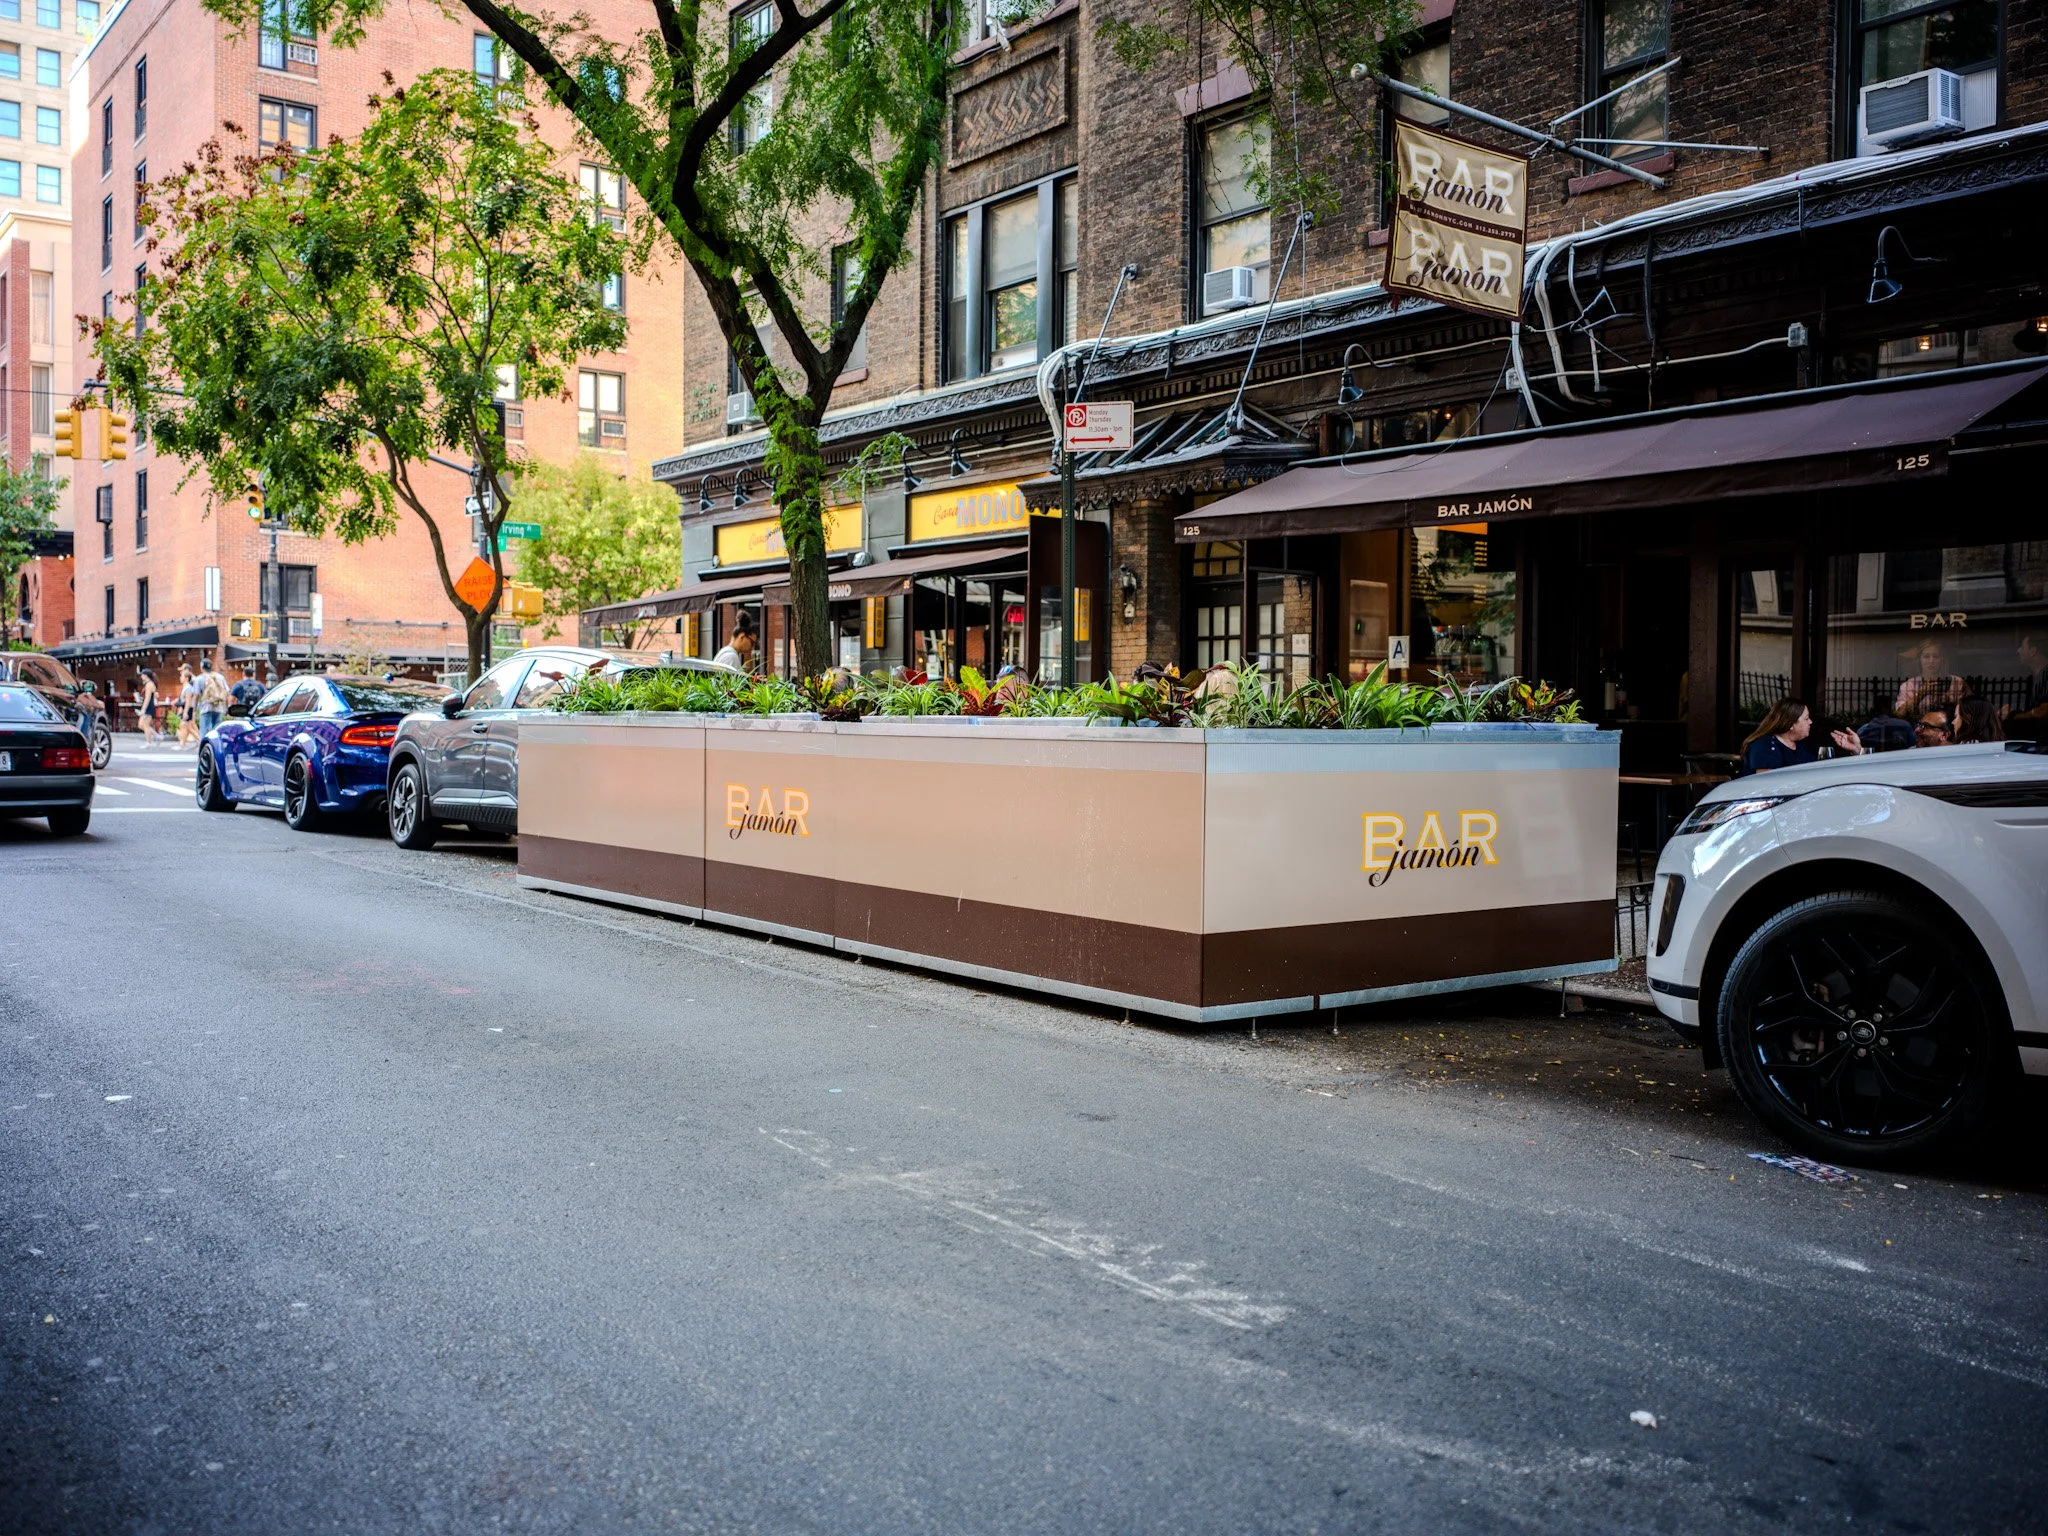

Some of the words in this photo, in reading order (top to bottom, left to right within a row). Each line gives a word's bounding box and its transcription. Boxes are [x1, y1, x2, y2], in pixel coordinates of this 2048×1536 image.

[1407, 143, 1516, 216] BAR
[1407, 167, 1508, 214] jamón
[1406, 226, 1512, 298] BAR
[1896, 454, 1930, 471] 125
[933, 505, 959, 525] Casa
[957, 488, 1026, 528] MONO
[1437, 503, 1470, 518] BAR
[1473, 493, 1533, 515] JAMÓN
[501, 523, 525, 538] Irving
[1183, 525, 1201, 536] 125
[464, 575, 494, 587] RAISE
[1910, 612, 1968, 630] BAR
[1392, 640, 1406, 660] A
[726, 782, 812, 838] BAR
[729, 804, 797, 840] jamón
[1360, 809, 1499, 872] BAR
[1368, 839, 1484, 888] jamón
